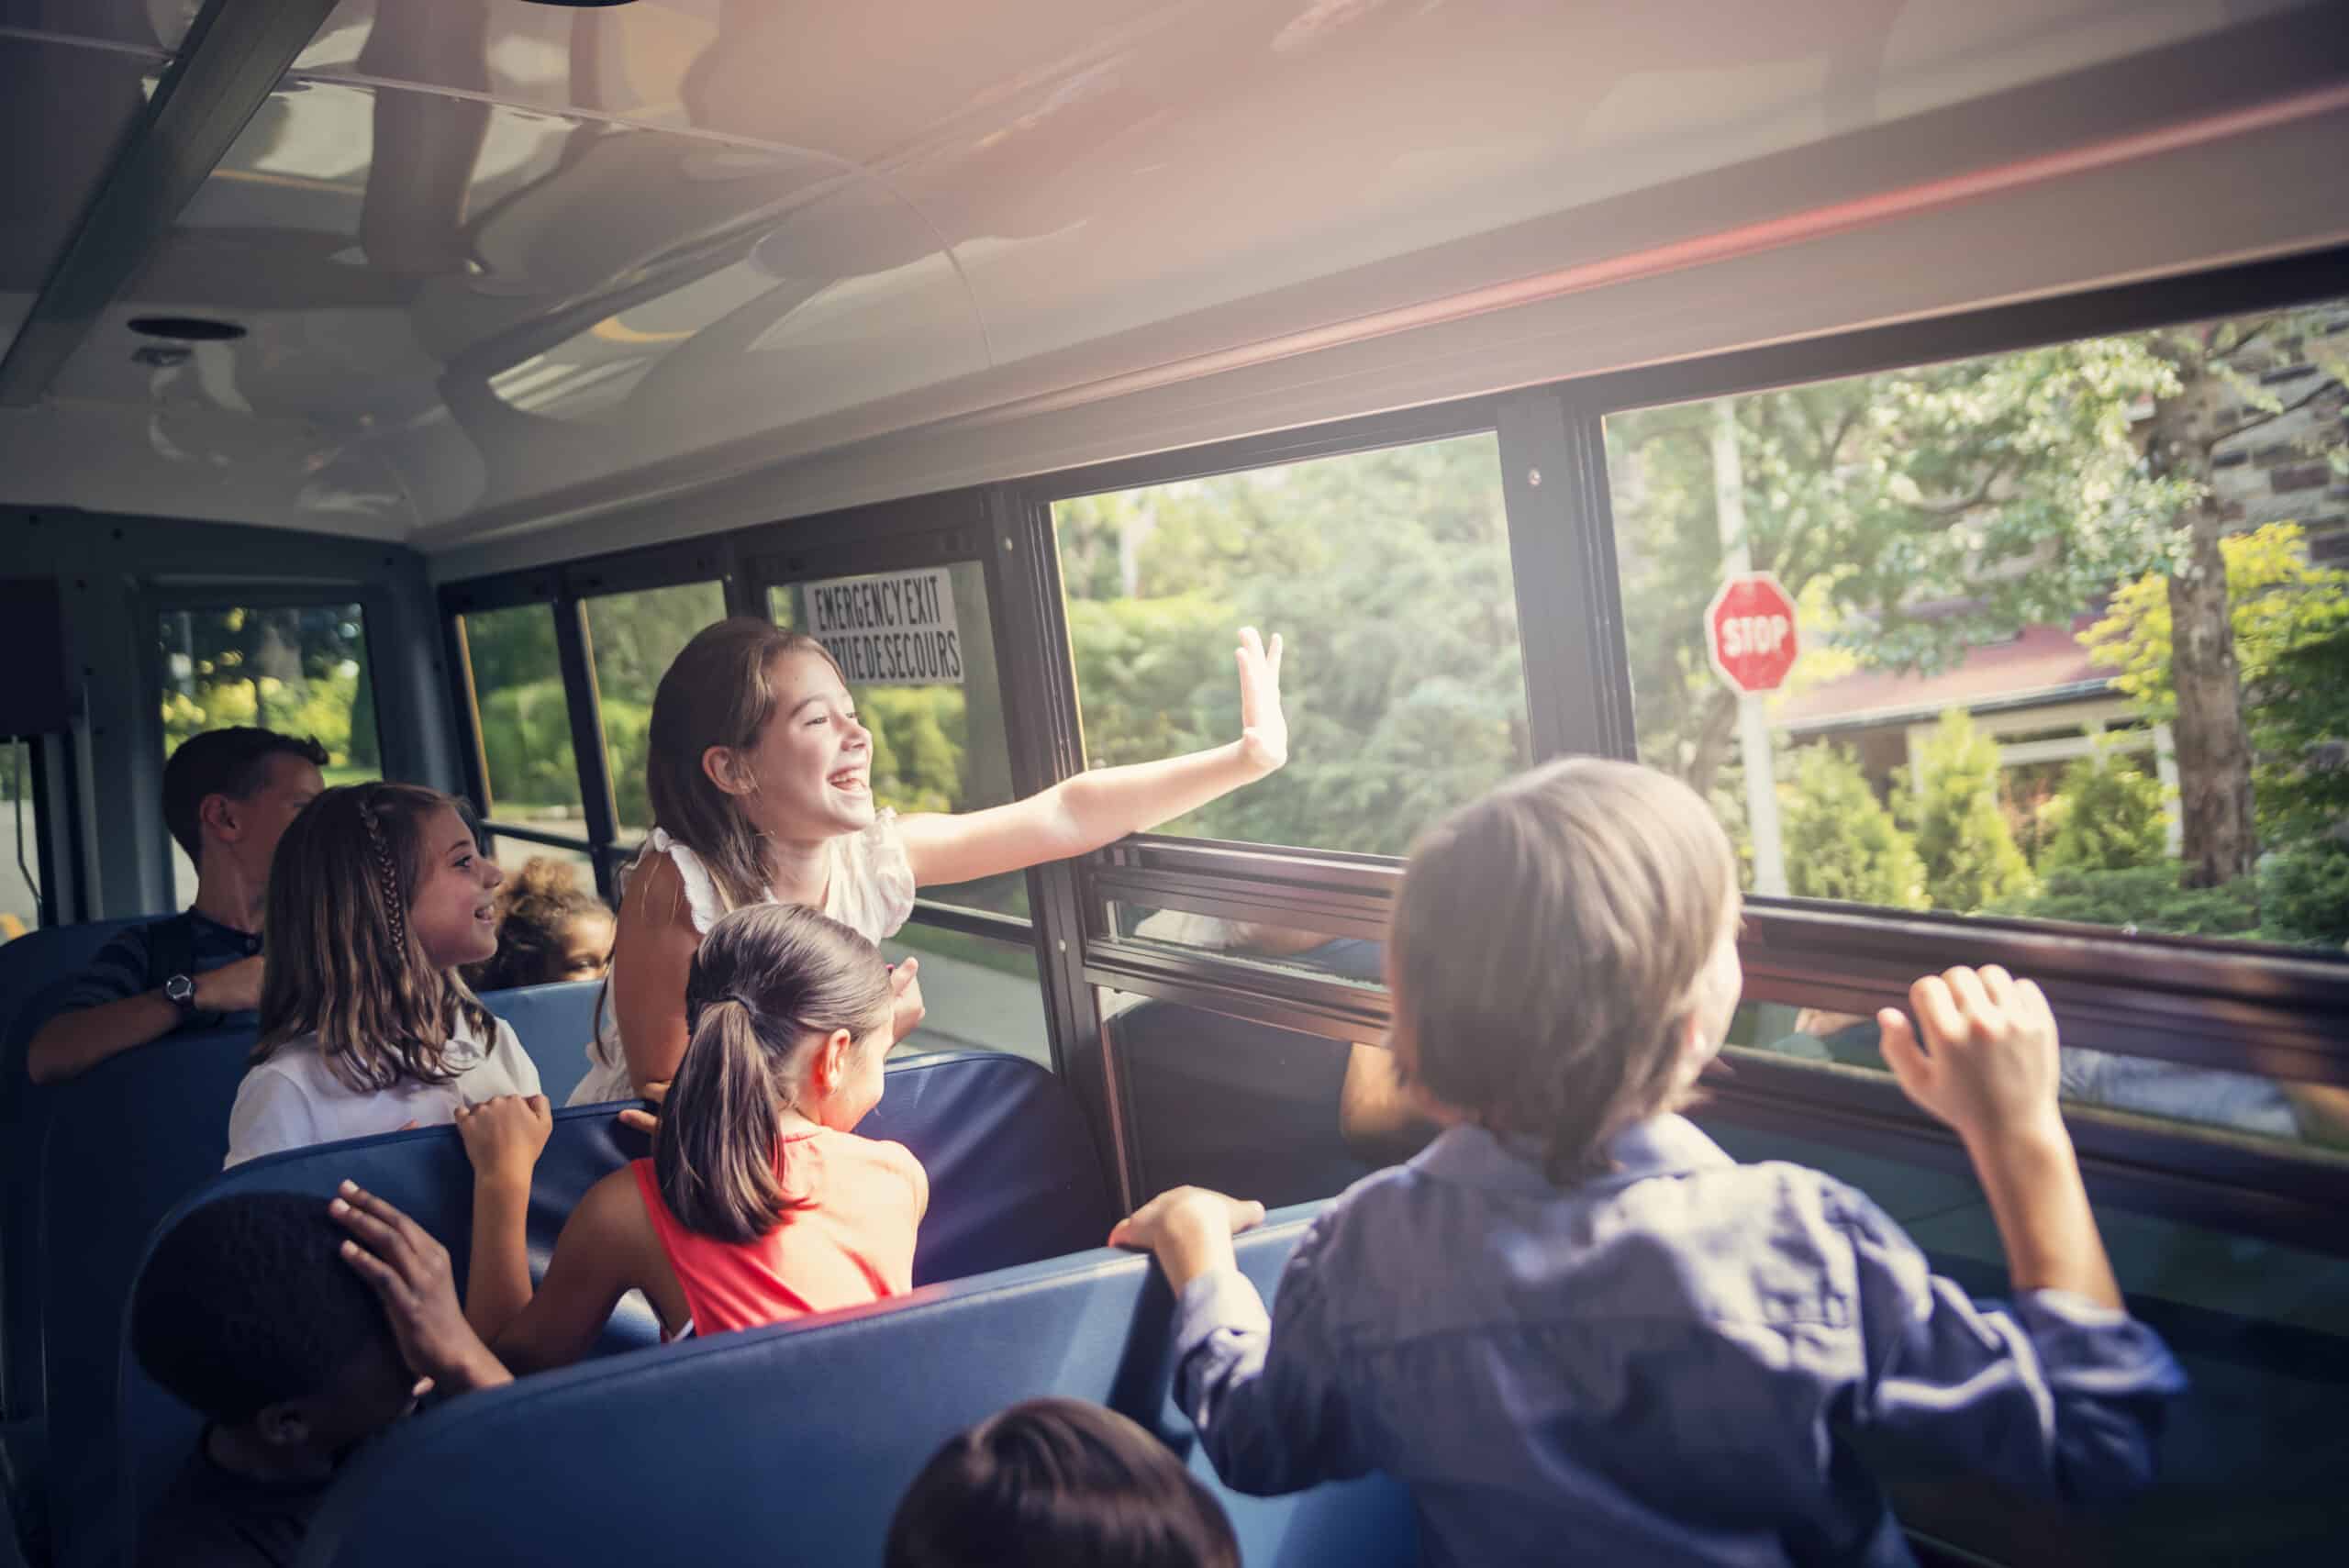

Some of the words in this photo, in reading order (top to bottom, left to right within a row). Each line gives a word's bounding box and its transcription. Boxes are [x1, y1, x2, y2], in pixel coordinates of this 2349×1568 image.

[815, 579, 904, 632] EMERGENCY
[904, 575, 941, 626] EXIT
[863, 634, 886, 679] DE
[884, 629, 961, 679] SECOURS
[1721, 614, 1789, 658] STOP
